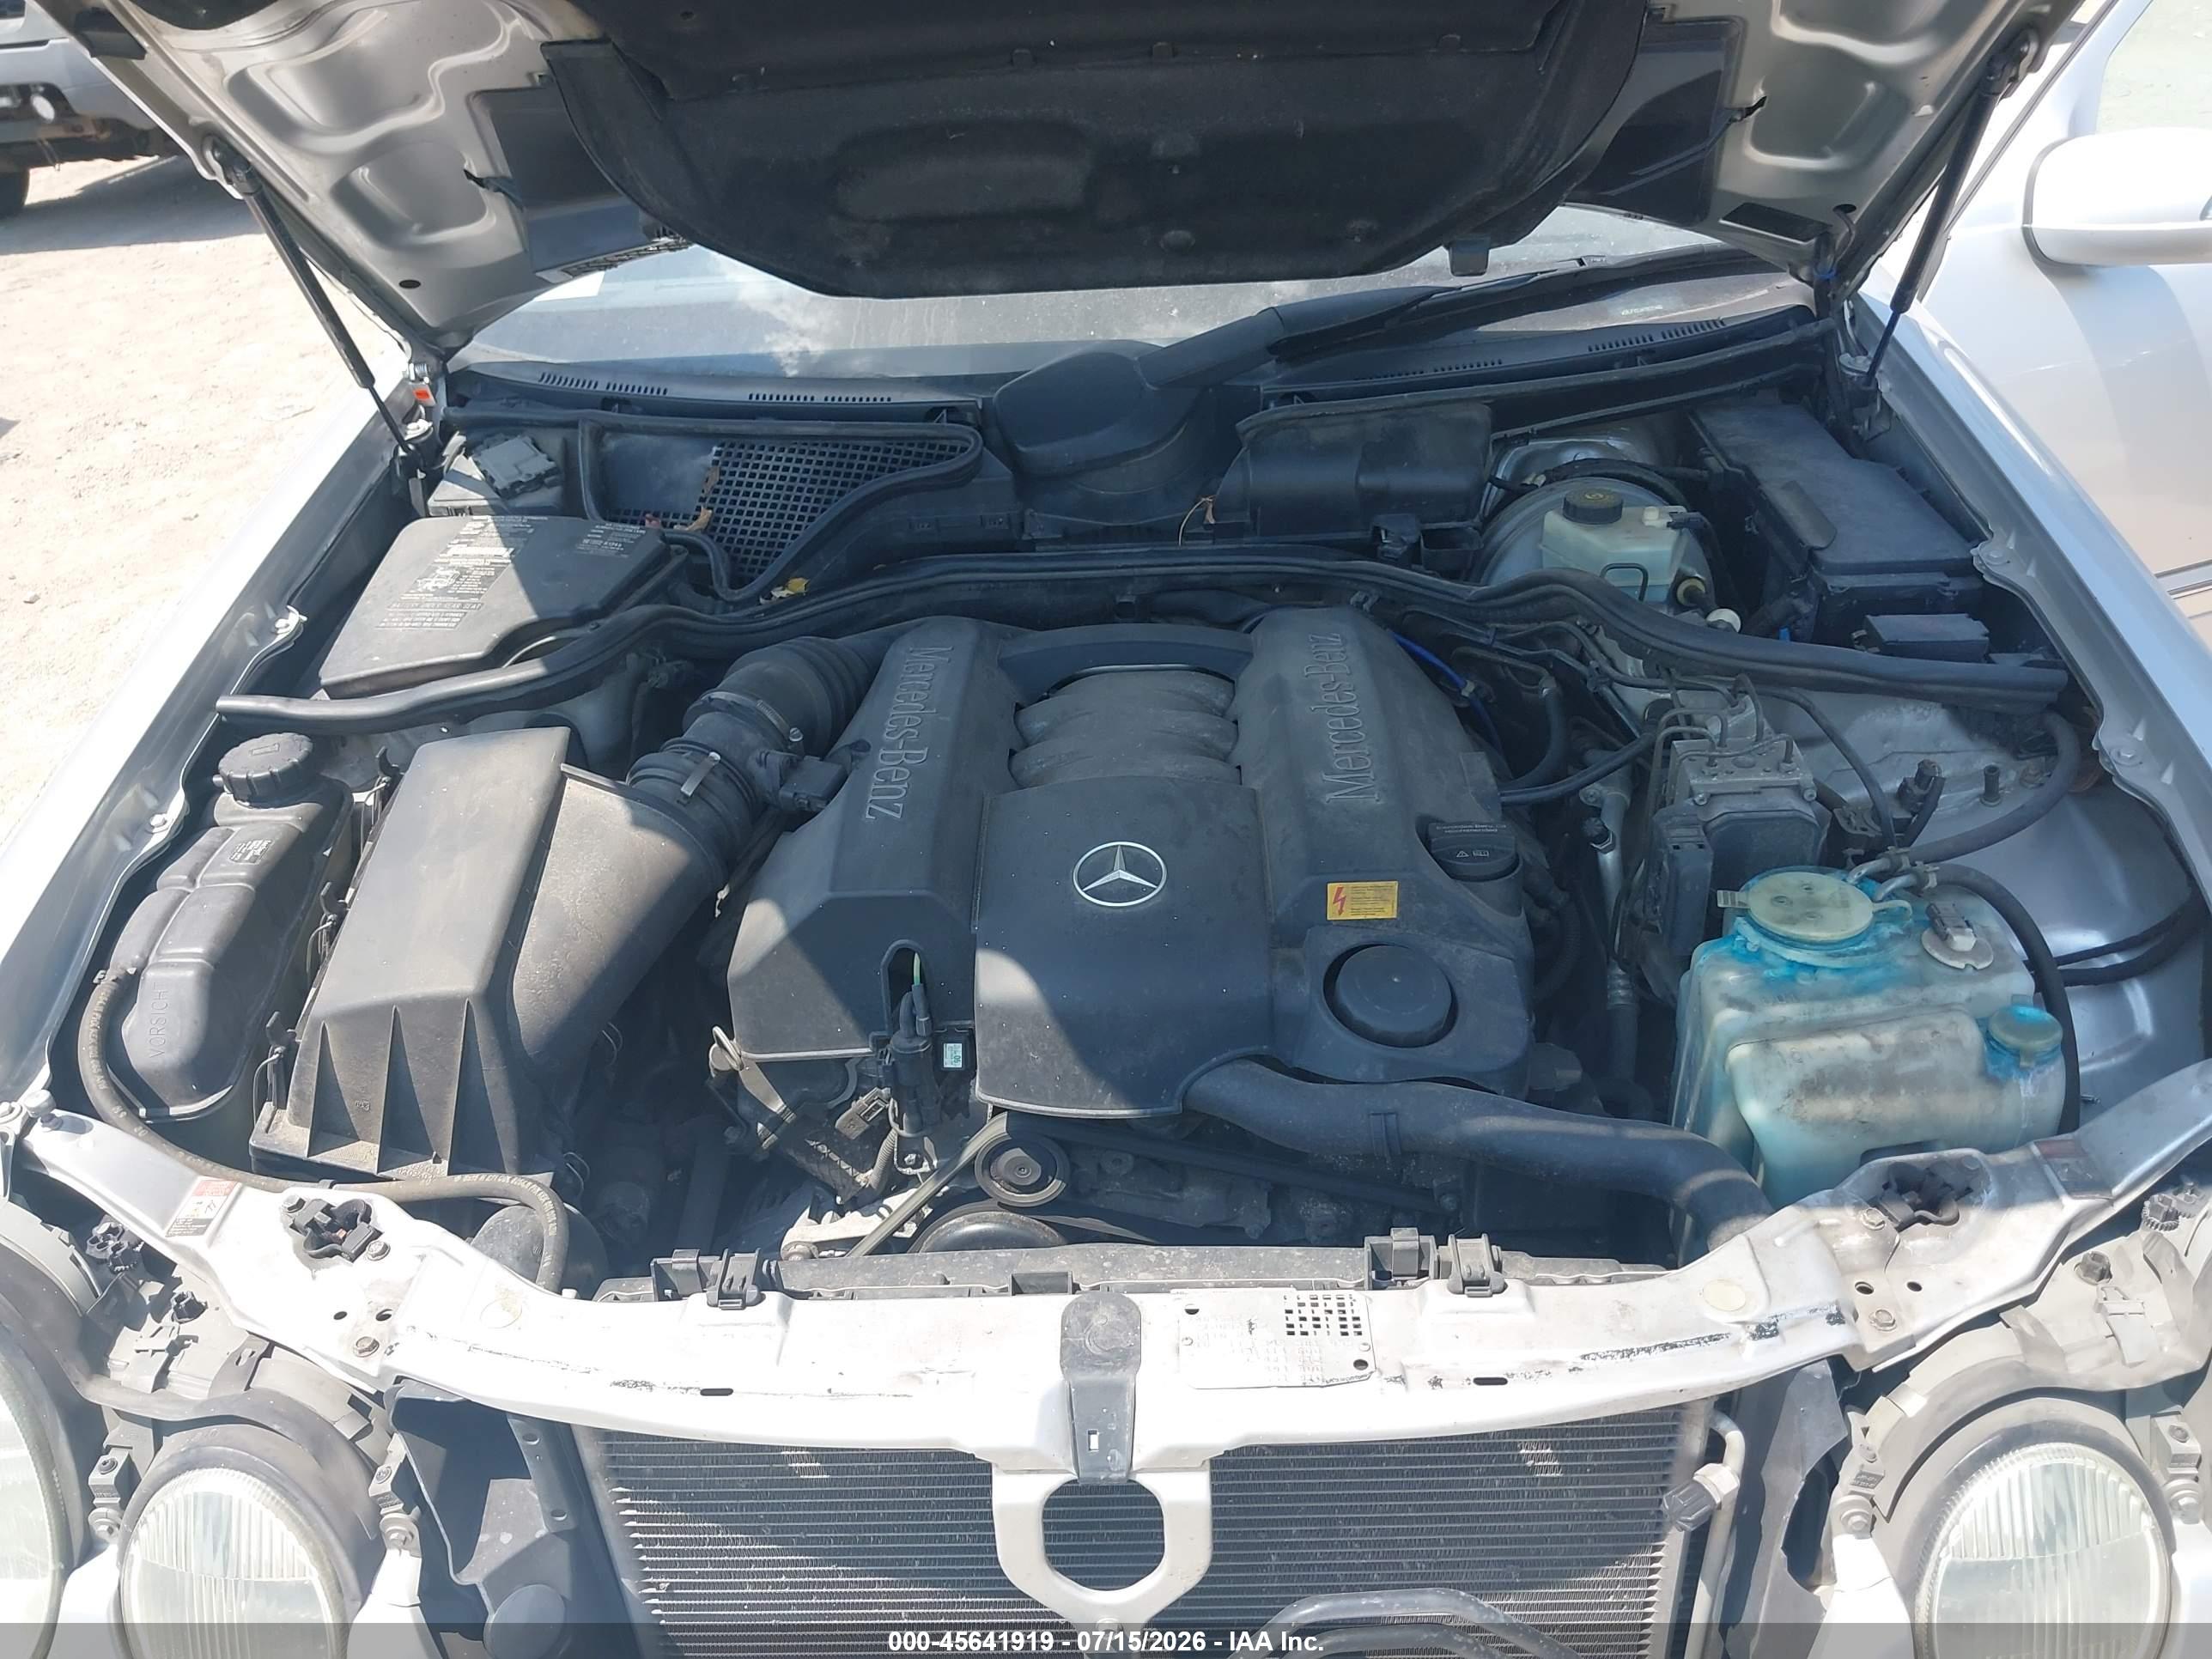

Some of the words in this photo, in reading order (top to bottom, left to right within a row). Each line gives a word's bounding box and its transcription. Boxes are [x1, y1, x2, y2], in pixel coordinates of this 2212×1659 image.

[865, 646, 954, 820] Mercedes-Benz
[1304, 633, 1381, 804] Mercedes-Benz
[149, 981, 169, 1058] VORSICHT
